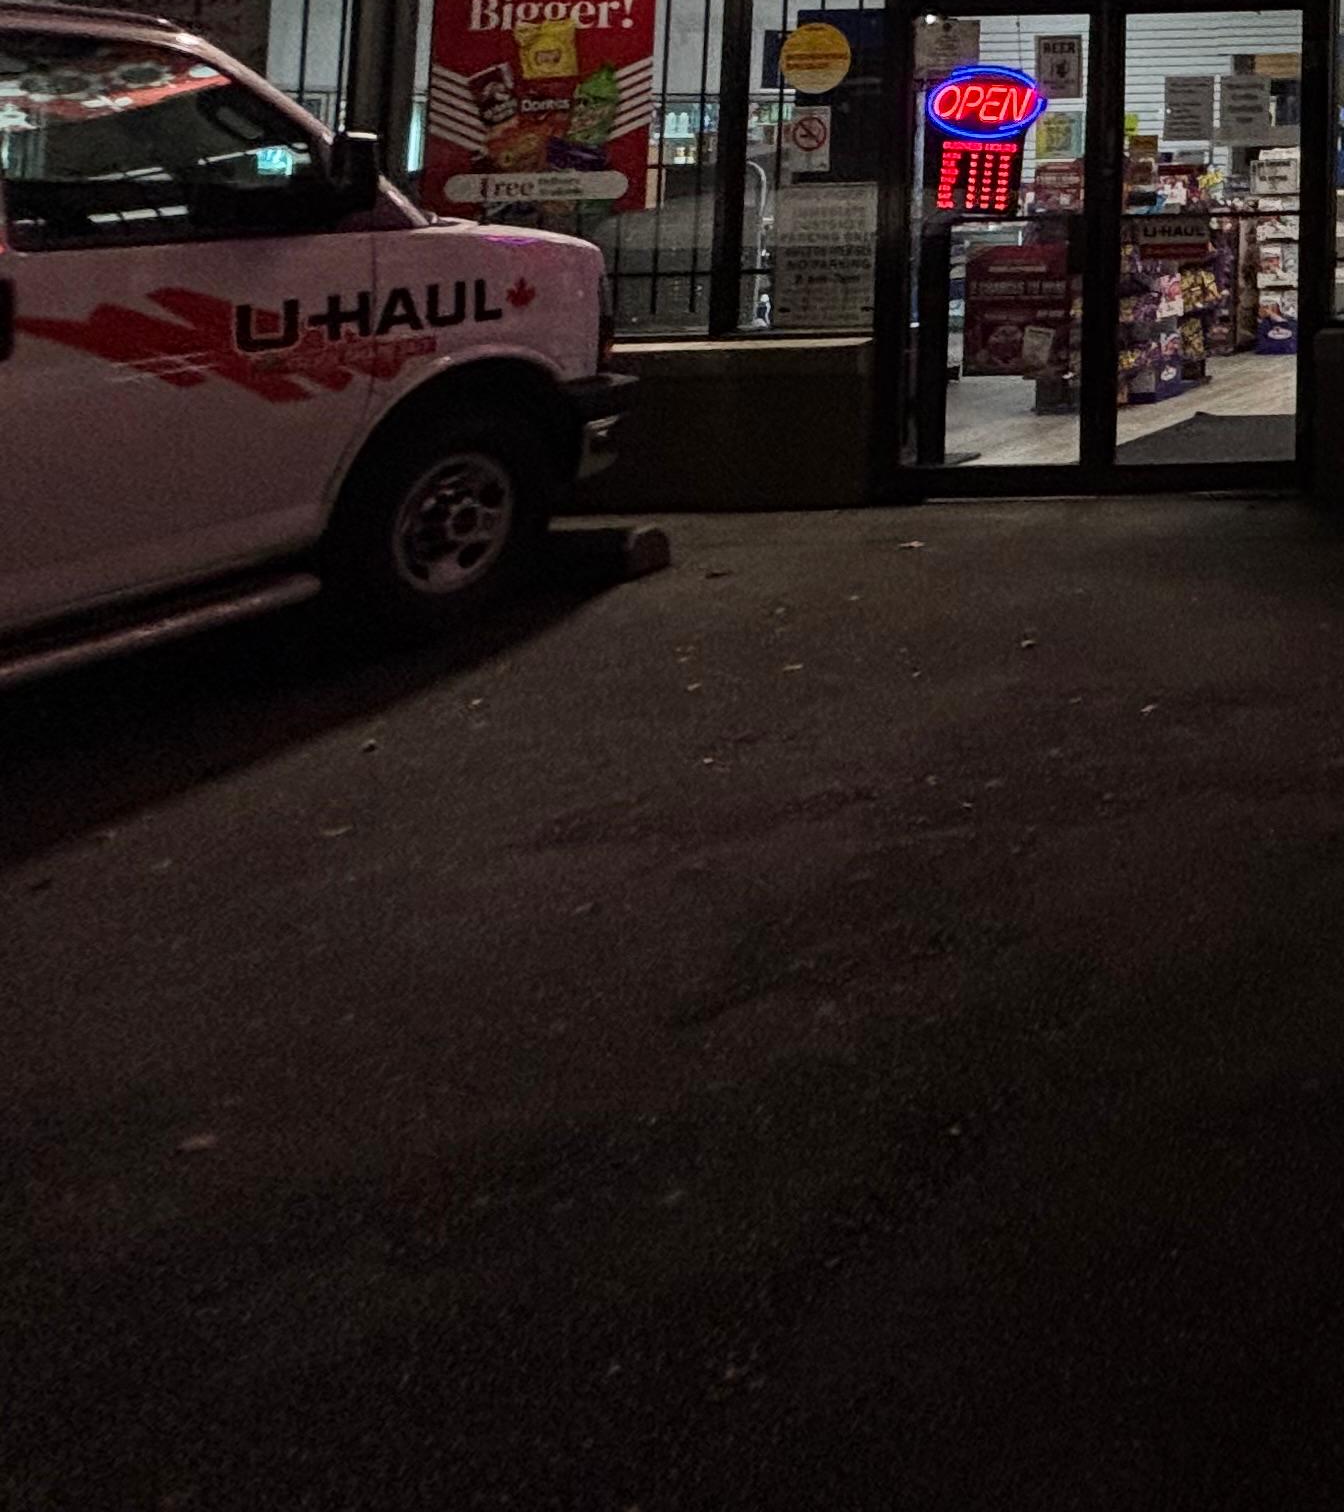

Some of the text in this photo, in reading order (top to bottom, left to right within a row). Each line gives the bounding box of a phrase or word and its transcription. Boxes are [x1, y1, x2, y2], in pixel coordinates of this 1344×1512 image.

[1043, 41, 1076, 54] BEER
[933, 84, 1034, 122] OPEN
[1143, 226, 1205, 237] U-HAUL
[234, 279, 503, 354] U-HAUL
